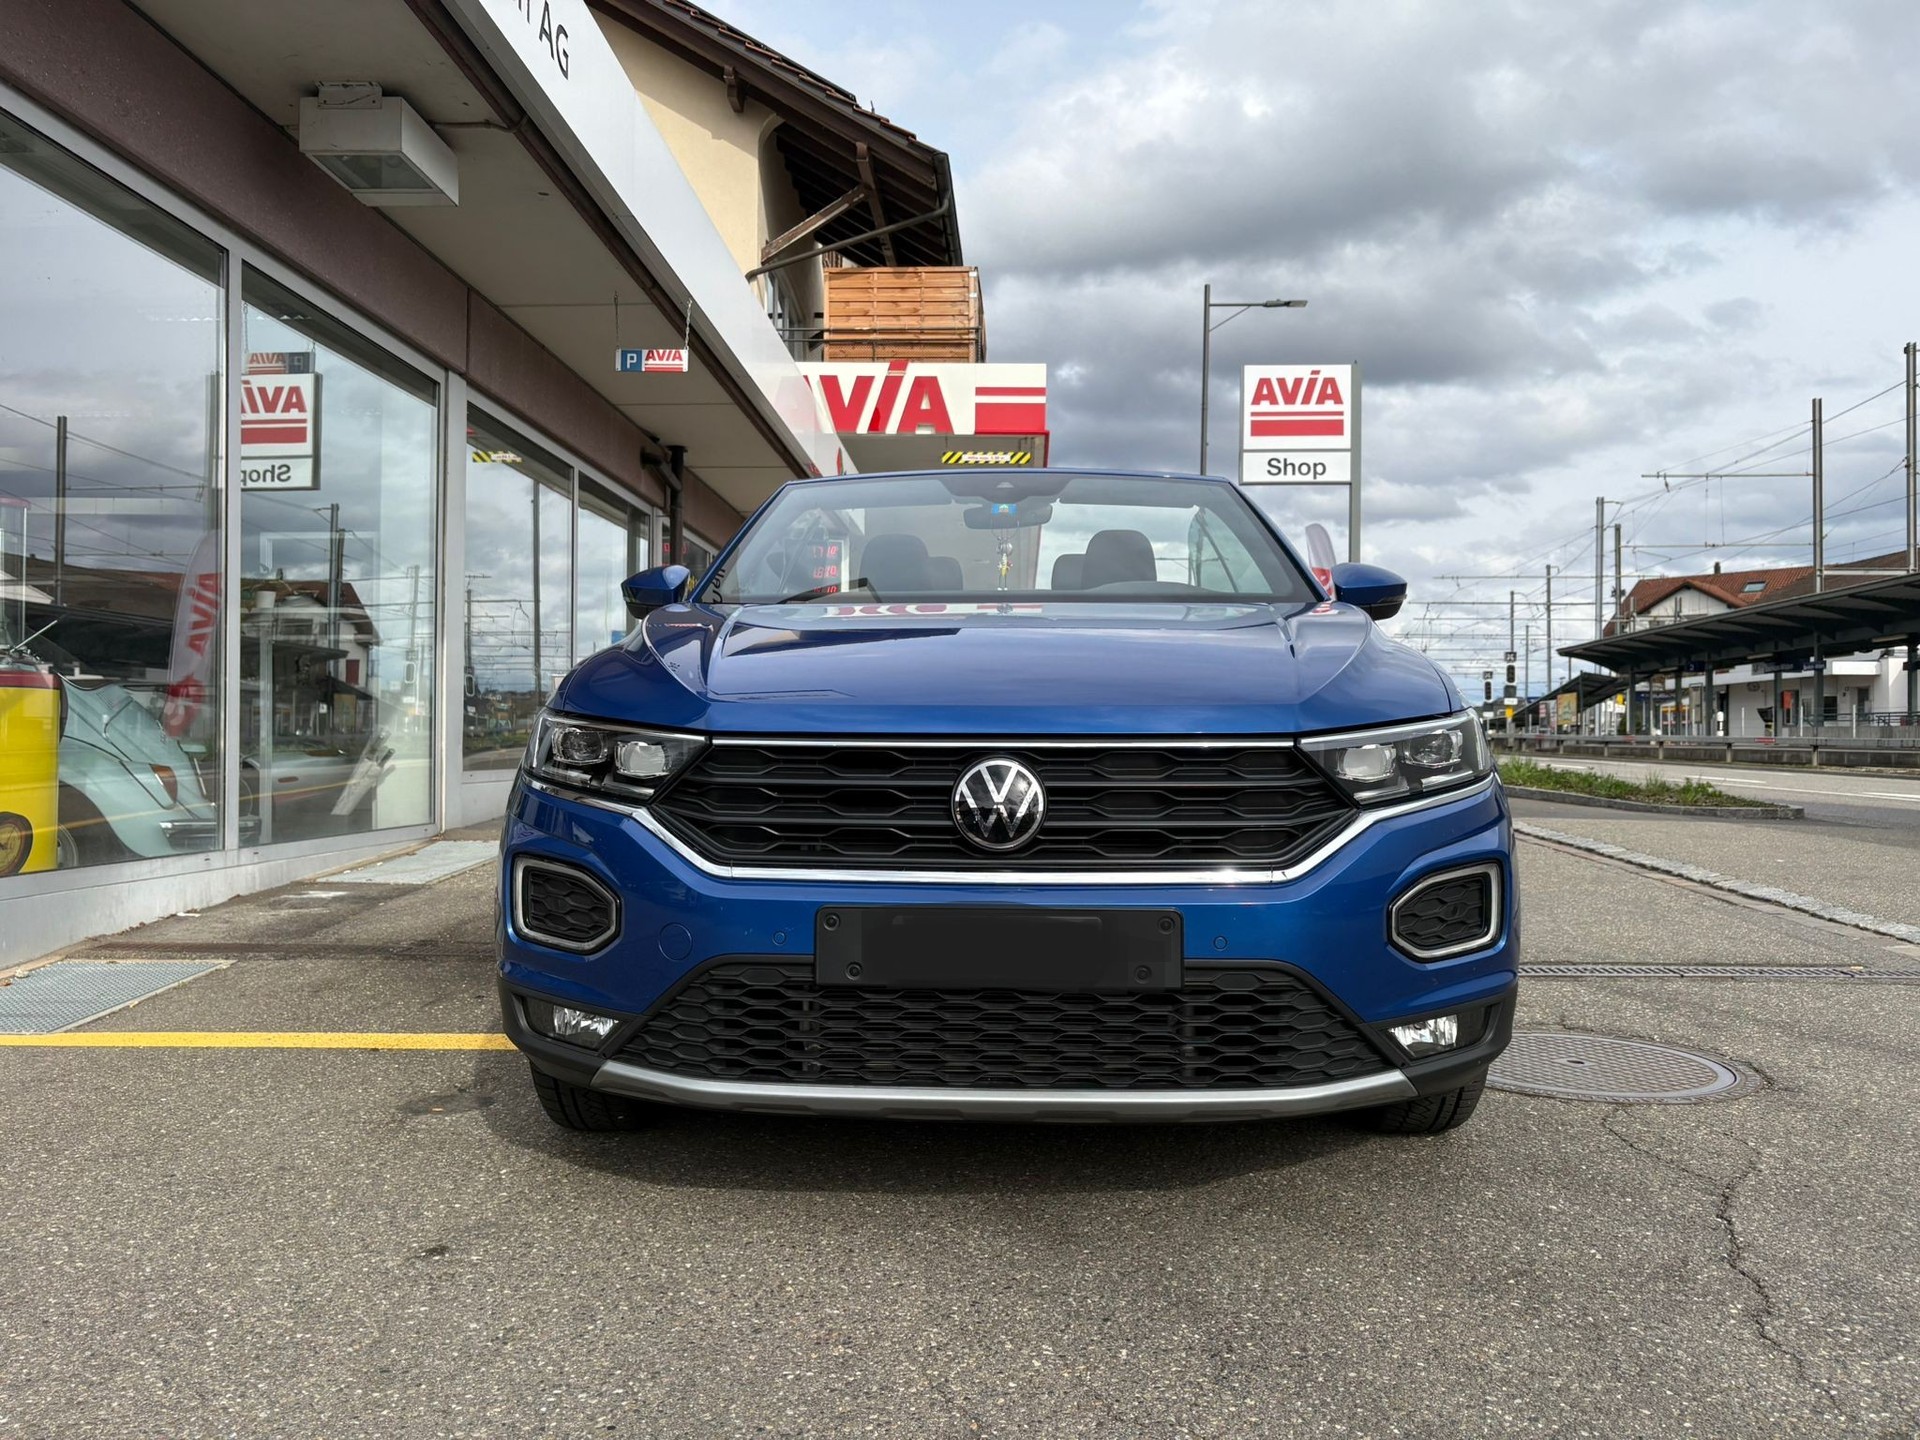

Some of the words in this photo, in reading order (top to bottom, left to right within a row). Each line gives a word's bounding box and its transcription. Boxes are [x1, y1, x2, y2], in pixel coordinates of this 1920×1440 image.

[539, 0, 568, 80] AG
[627, 353, 637, 369] P
[645, 350, 683, 361] AVIA
[803, 359, 955, 434] VIA
[1250, 370, 1343, 405] AVIA
[1266, 457, 1327, 480] Shop
